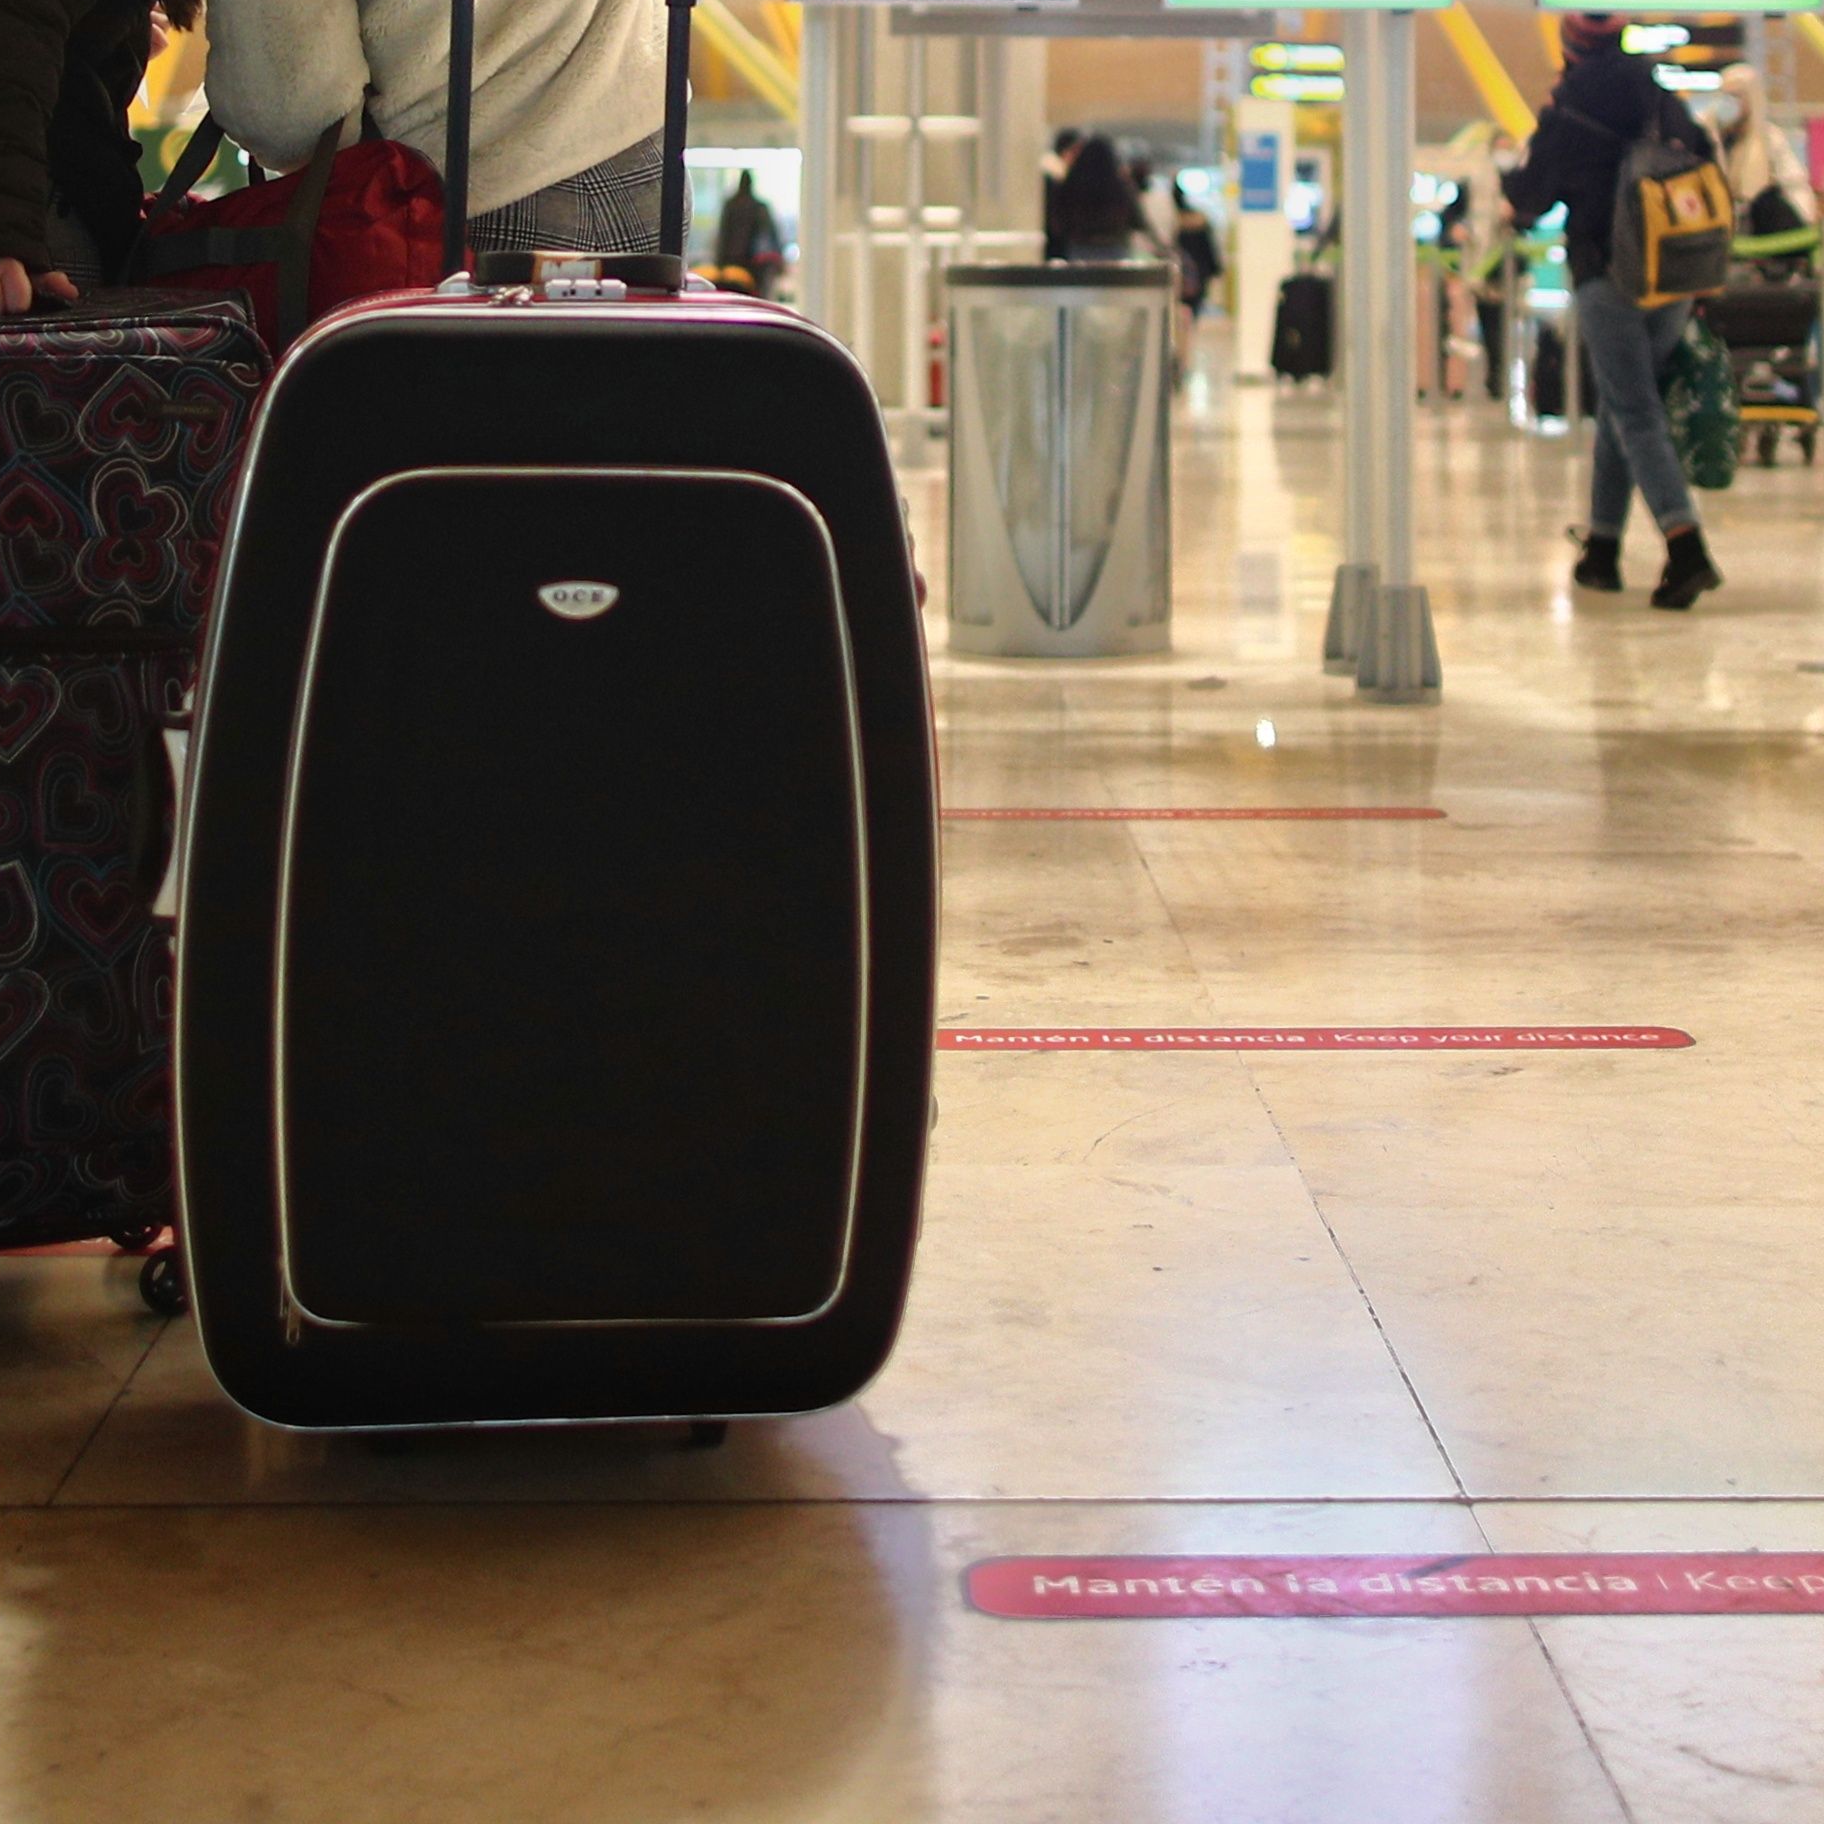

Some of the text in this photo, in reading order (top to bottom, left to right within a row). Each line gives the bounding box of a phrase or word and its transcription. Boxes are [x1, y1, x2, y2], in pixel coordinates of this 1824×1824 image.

[955, 1032, 1660, 1044] Mantén la distancia Keep your distance
[1032, 1570, 1266, 1596] Mantén
[1284, 1573, 1339, 1595] la
[1359, 1571, 1640, 1595] distancia
